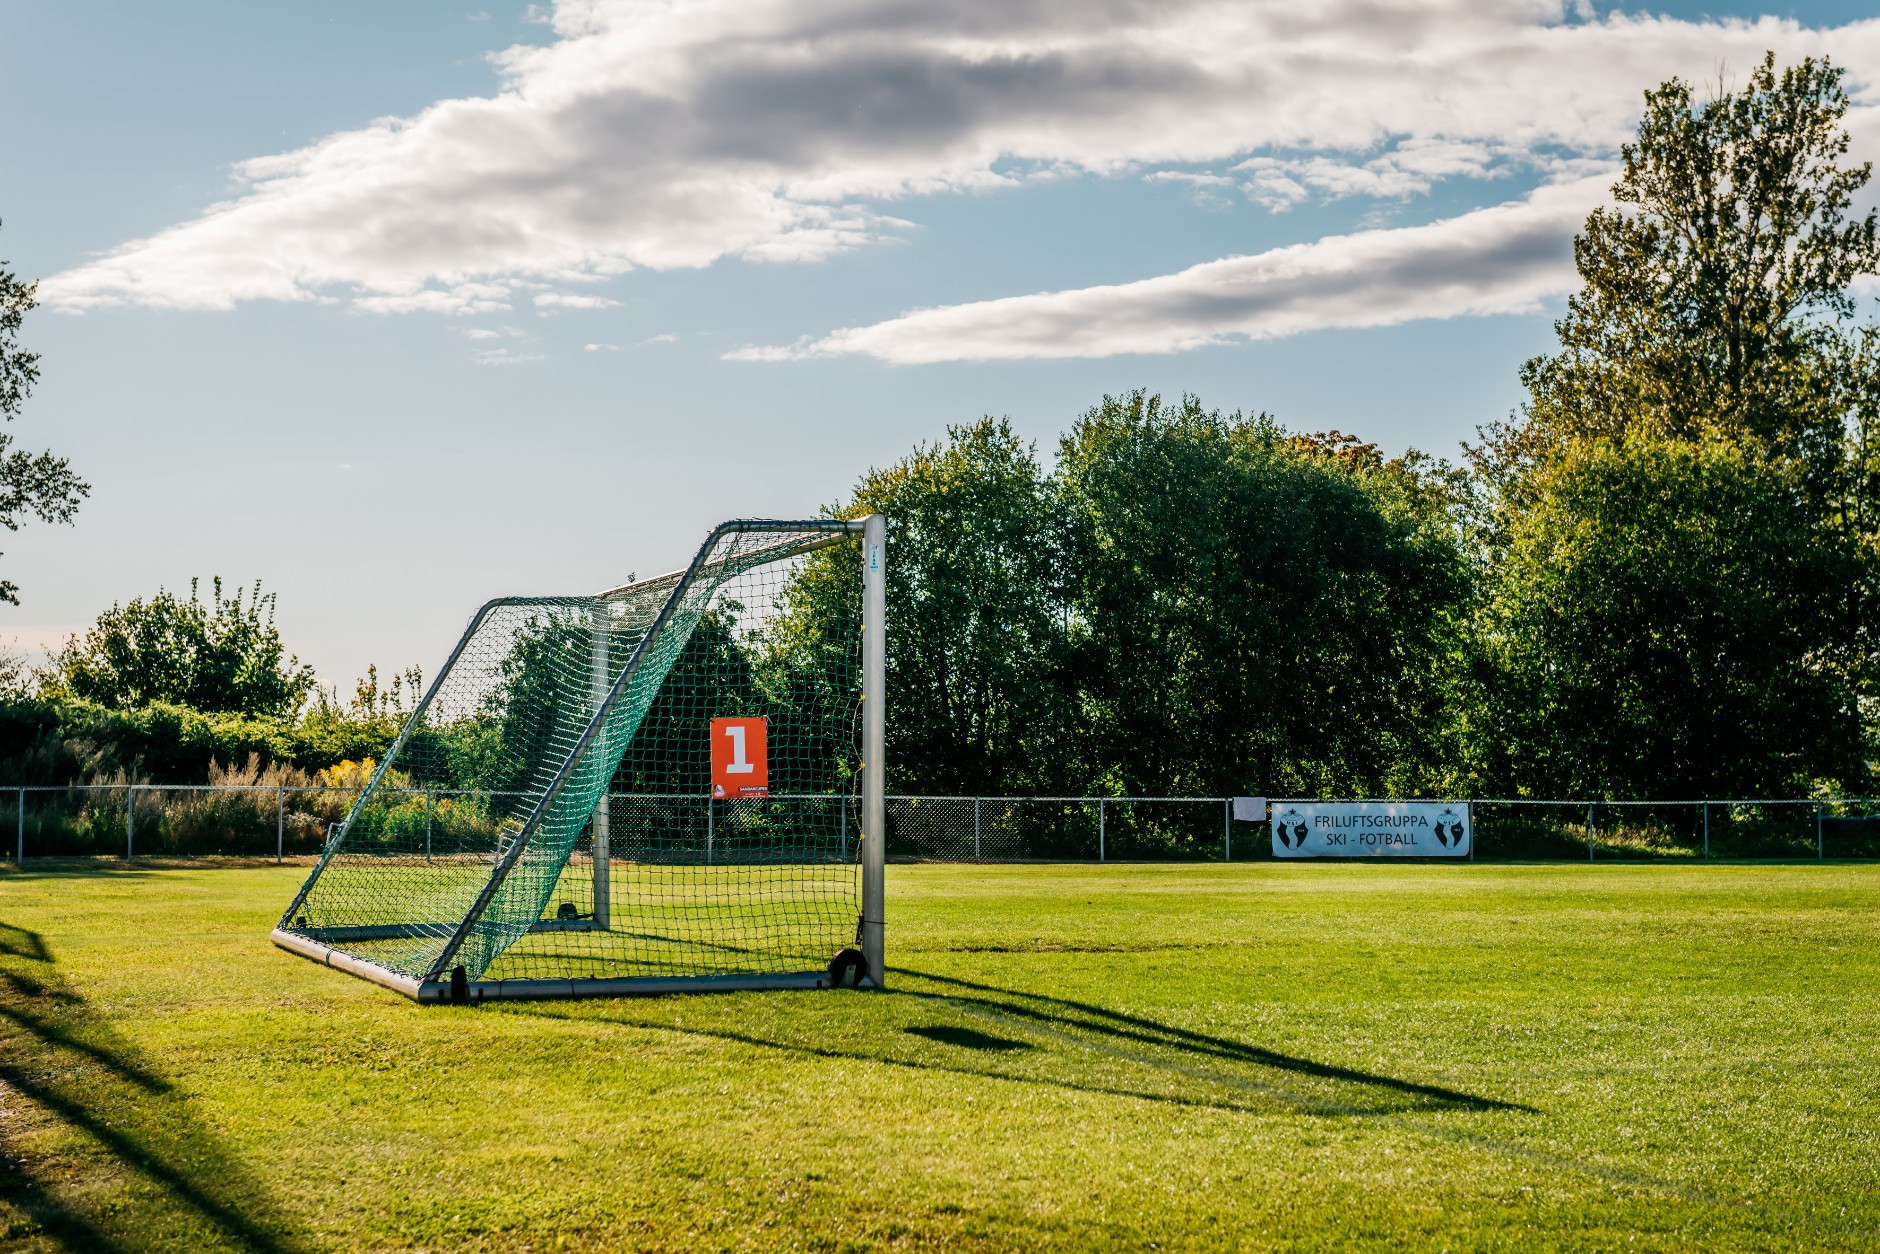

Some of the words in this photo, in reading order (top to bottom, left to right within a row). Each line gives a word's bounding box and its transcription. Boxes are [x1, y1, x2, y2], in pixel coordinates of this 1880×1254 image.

[725, 726, 754, 773] 1
[1314, 815, 1429, 828] FRILUFTSGRUPPA
[1326, 833, 1347, 846] SKI
[1359, 833, 1418, 845] FOTBALL
